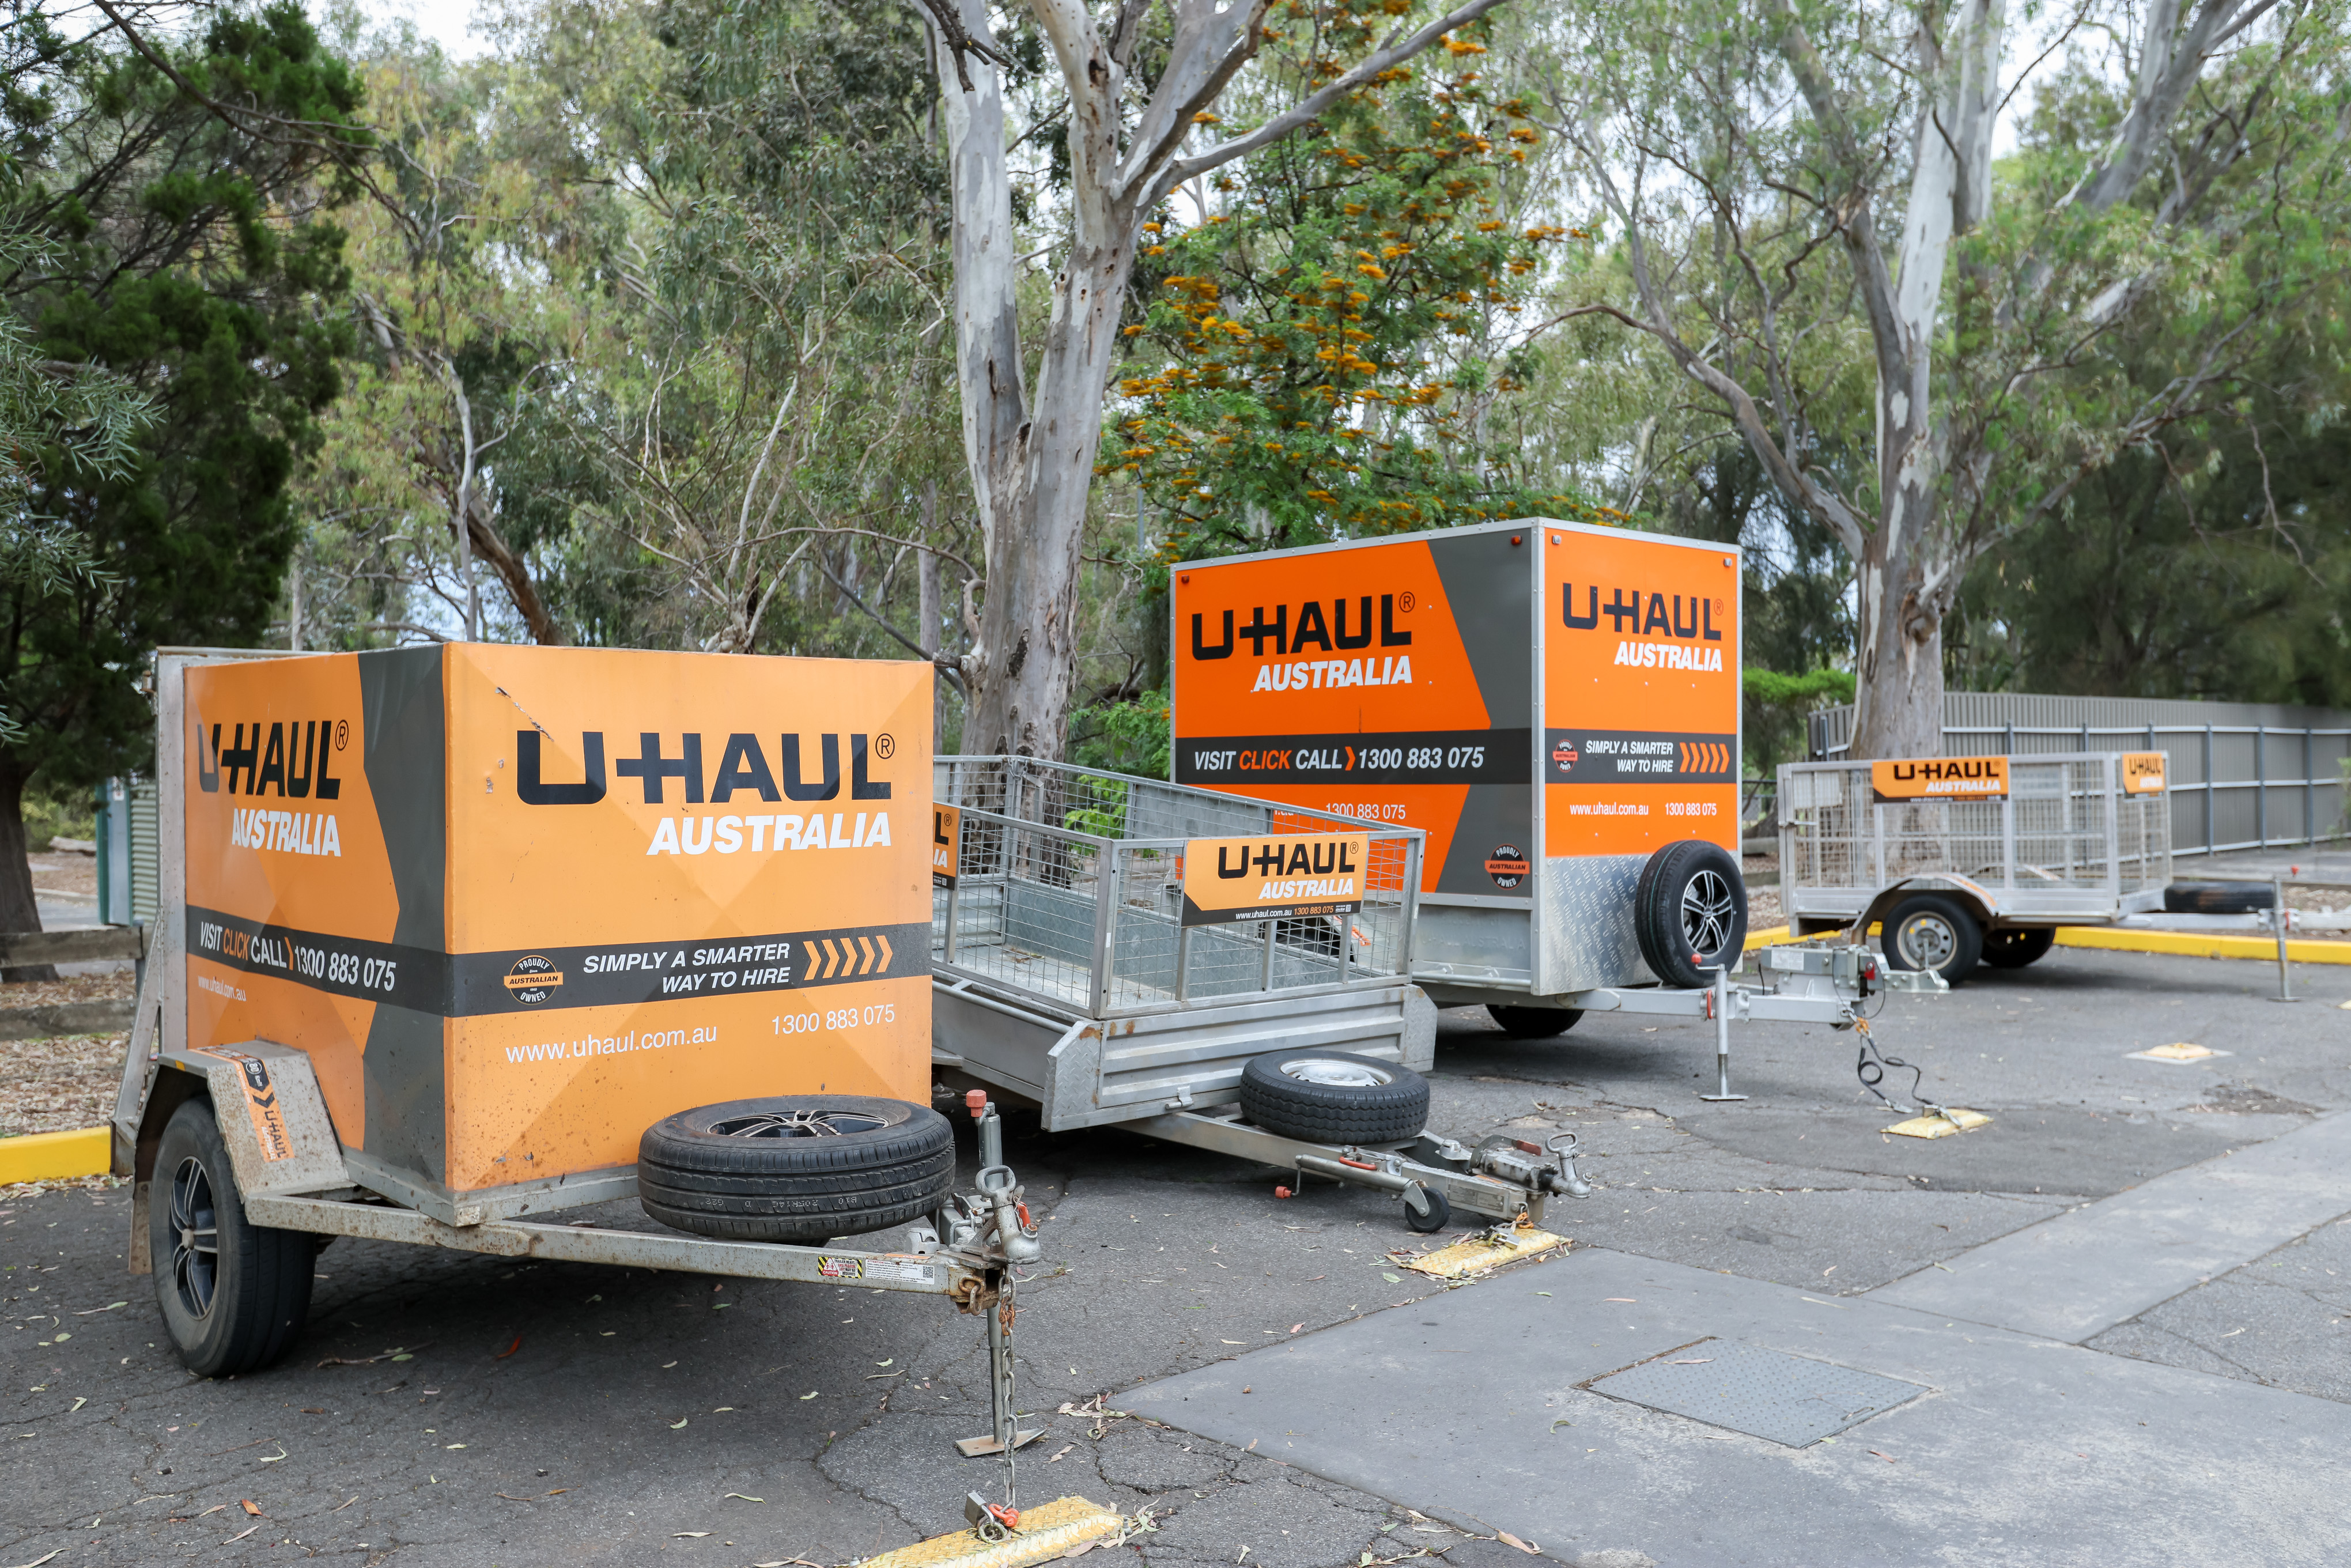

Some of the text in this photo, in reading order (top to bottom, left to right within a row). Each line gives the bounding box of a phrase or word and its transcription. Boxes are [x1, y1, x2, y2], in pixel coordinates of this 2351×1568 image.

[1613, 641, 1722, 672] AUSTRALIA
[1253, 655, 1412, 692] AUSTRALIA
[1585, 740, 1673, 755] SIMPLY A SMARTER
[1195, 747, 1484, 770] VISIT CLICK CALL 1300 883 075
[1617, 759, 1673, 773] WAY TO HIRE
[1925, 780, 2001, 793] AUSTRALIA
[1326, 803, 1406, 819] 1300 883 075
[1570, 802, 1649, 816] www.uhaul.com.au
[1665, 802, 1717, 816] 1300 883 075
[232, 808, 341, 857] AUSTRALIA
[646, 812, 891, 856] AUSTRALIA
[1496, 846, 1520, 858] PROUDLY
[1258, 878, 1354, 900] AUSTRALIA
[1497, 876, 1517, 887] OWNED
[1235, 909, 1292, 920] www.uhaul.com.au
[1294, 907, 1309, 915] 1300
[1310, 906, 1321, 915] 883
[1322, 905, 1334, 914] 075
[201, 921, 396, 992] VISIT CLICK CALL 1300 883 075
[519, 958, 550, 970] PROUDLY
[583, 943, 790, 974] SIMPLY A SMARTER
[198, 976, 247, 1002] www.uhaul.com.au
[509, 976, 558, 985] AUSTRALIAN
[663, 967, 790, 993] WAY TO HIRE
[520, 991, 546, 1002] OWNED
[772, 1004, 895, 1035] 1300 883 075
[505, 1023, 718, 1064] www.uhaul.com.au
